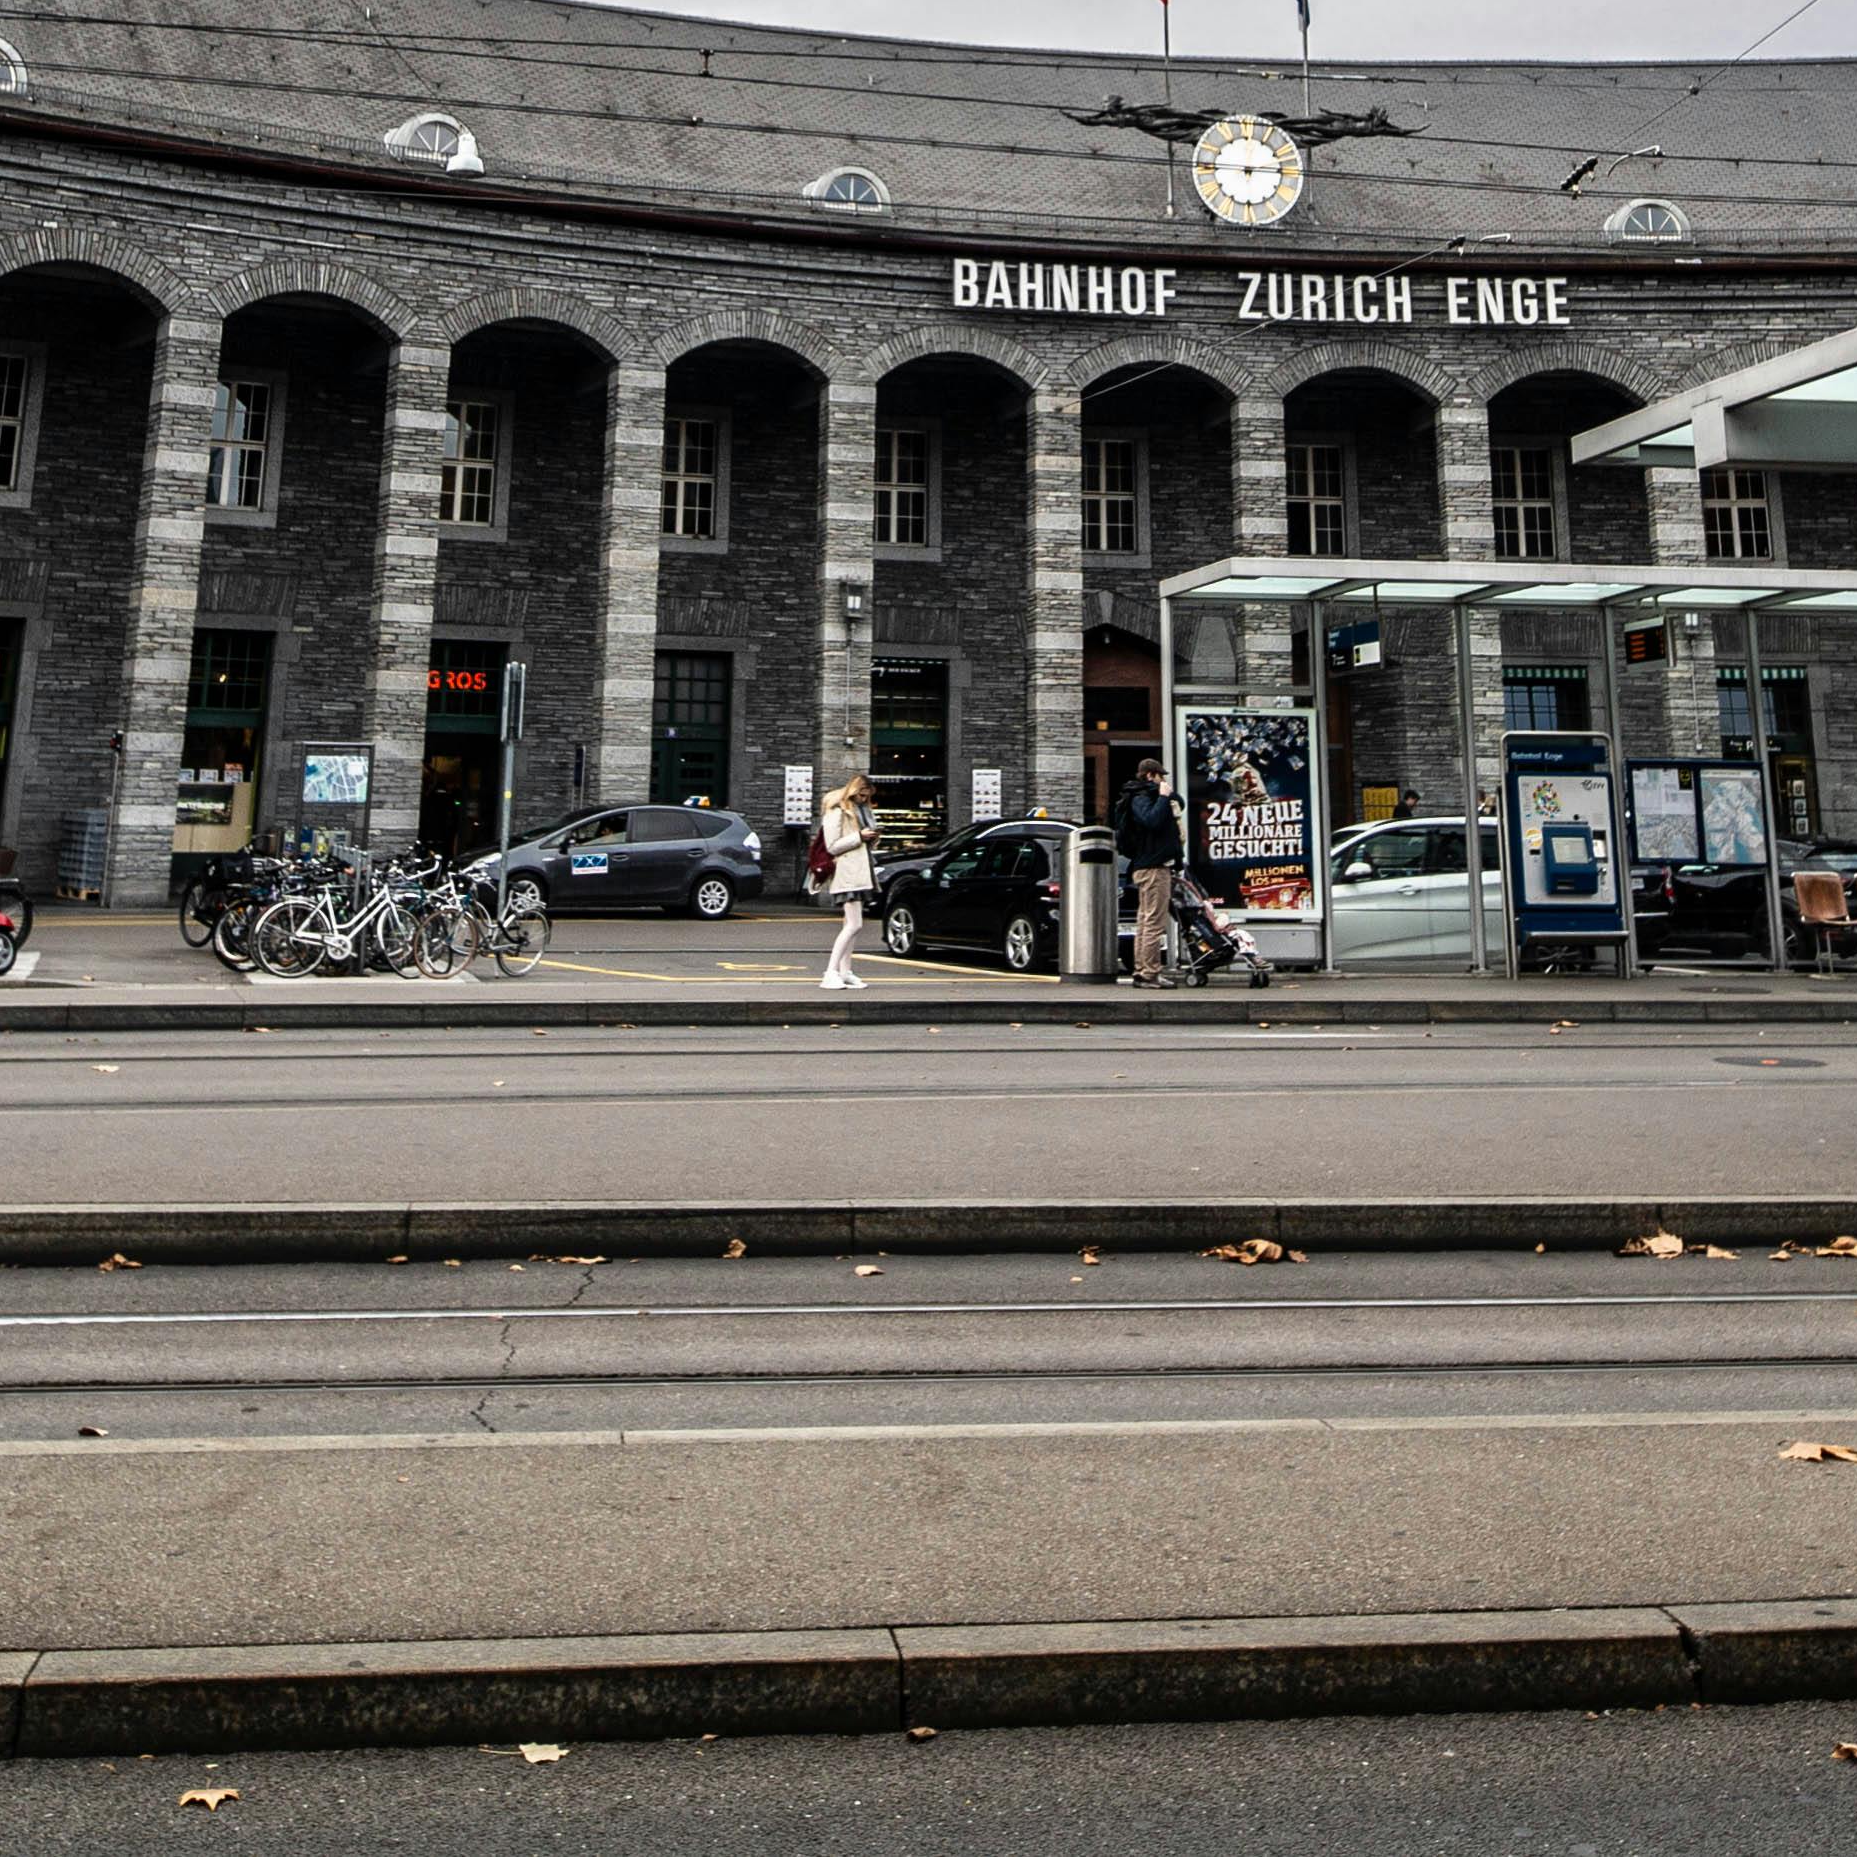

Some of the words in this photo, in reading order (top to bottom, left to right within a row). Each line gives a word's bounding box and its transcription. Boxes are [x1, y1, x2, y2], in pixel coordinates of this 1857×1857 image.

[953, 258, 1176, 316] BAHNHOF
[1238, 271, 1412, 324] ZURICH
[1447, 277, 1571, 326] ENGE
[428, 670, 487, 690] GROS
[1206, 802, 1237, 825] 24
[1242, 799, 1304, 826] NEUE
[1208, 839, 1303, 860] GESUCHT!
[1251, 876, 1270, 886] LOS
